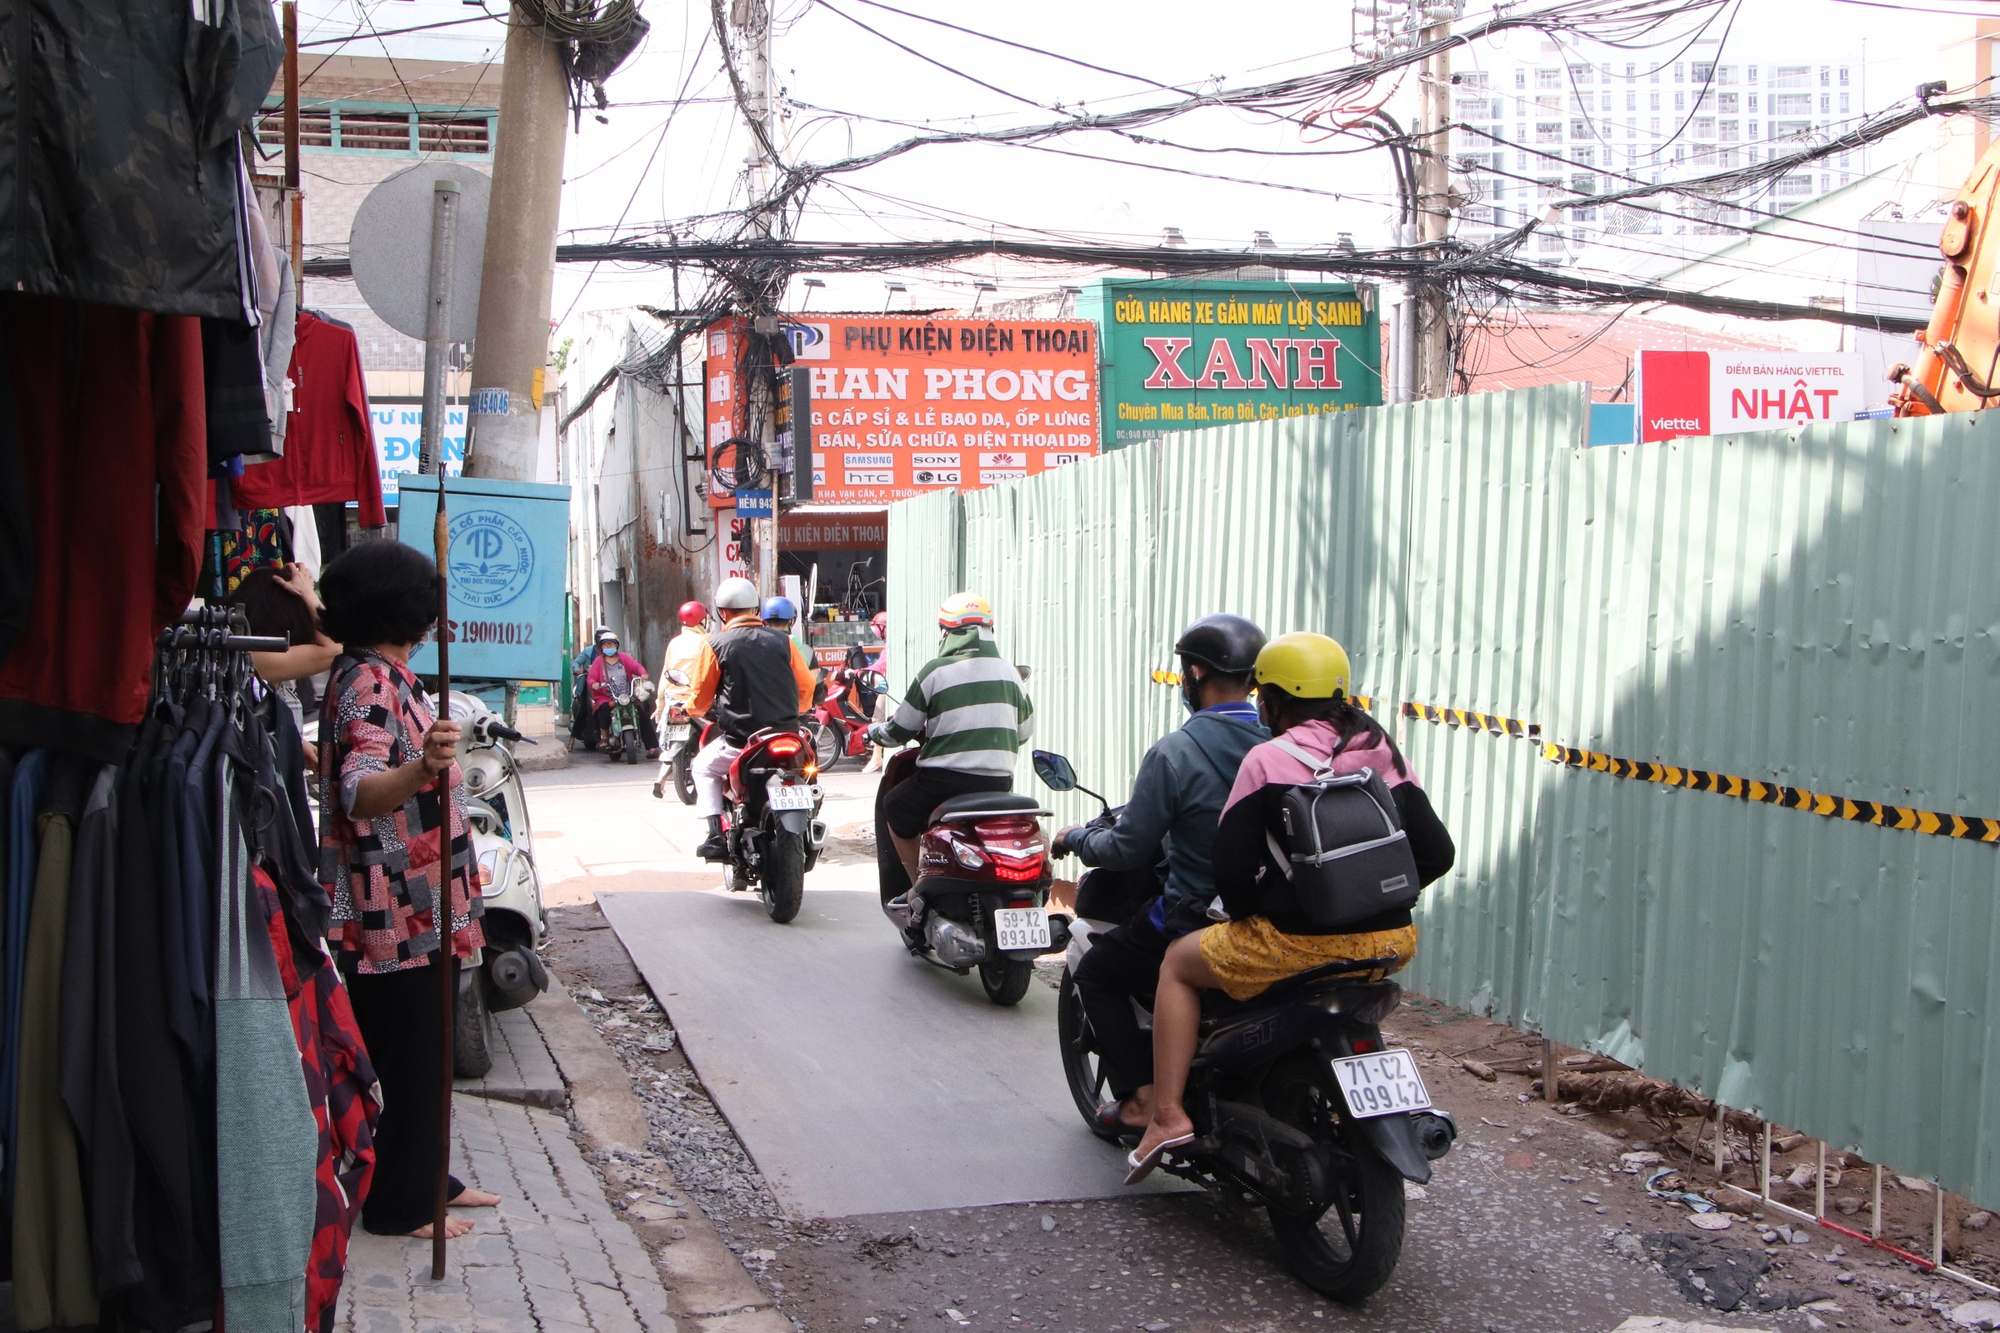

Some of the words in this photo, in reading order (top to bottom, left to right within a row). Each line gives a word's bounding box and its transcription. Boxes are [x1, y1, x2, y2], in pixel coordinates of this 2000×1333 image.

[1115, 294, 1146, 324] CỬA
[1149, 296, 1192, 324] HÀNG
[1194, 302, 1214, 324] XE
[1217, 294, 1249, 325] GẮN
[1252, 299, 1283, 326] MÁY
[1288, 300, 1313, 331] LỢI
[1316, 301, 1362, 326] SANH
[844, 325, 892, 356] PHỤ
[899, 321, 952, 356] KIỆN
[960, 322, 1014, 357] ĐIỆN
[1021, 328, 1089, 358] THOẠI
[1143, 336, 1342, 389] XANH
[1725, 360, 1751, 375] ĐIỂM
[1753, 363, 1774, 376] BÁN
[1776, 362, 1805, 376] HÀNG
[1806, 366, 1844, 376] VIETTEL
[924, 368, 1090, 402] PHONG
[1118, 402, 1158, 422] Chuyên
[1160, 402, 1184, 420] Mua
[1187, 401, 1210, 422] Bán,
[1211, 402, 1234, 420] Trao
[1237, 400, 1257, 422] Đổi,
[1259, 401, 1278, 420] Các
[1732, 379, 1838, 426] NHẬT
[828, 406, 868, 426] CẤP
[872, 406, 891, 426] SỈ
[896, 412, 910, 426] &
[914, 407, 936, 426] LẺ
[942, 412, 978, 426] BAO
[981, 412, 1011, 428] DA,
[1015, 407, 1040, 426] ỐP
[1044, 410, 1091, 427] LƯNG
[1650, 416, 1701, 430] viettel
[819, 431, 862, 450] BÁN,
[866, 428, 901, 448] SỬA
[907, 428, 958, 448] CHỮA
[963, 429, 1007, 450] ĐIỆN
[1010, 433, 1067, 450] THOẠI
[1069, 433, 1092, 448] DĐ
[1142, 430, 1156, 440] KHA
[846, 456, 892, 464] SAMSUNG
[914, 456, 959, 464] SONY
[938, 474, 958, 482] LG
[738, 493, 757, 509] HẺM
[818, 490, 836, 498] KHA
[838, 490, 856, 500] VẠN
[858, 488, 879, 500] CÂN,
[880, 490, 888, 498] P.
[794, 522, 820, 546] KIỆN
[824, 522, 850, 546] ĐIỆN
[852, 525, 885, 545] THOẠI
[462, 620, 533, 646] 19001012
[772, 798, 811, 809] 169.81
[774, 787, 804, 798] 50-X1
[1003, 912, 1041, 928] 59-X2
[1000, 929, 1047, 947] 893.40
[1344, 1056, 1407, 1086] 71-C2
[1350, 1081, 1425, 1112] 099.42
